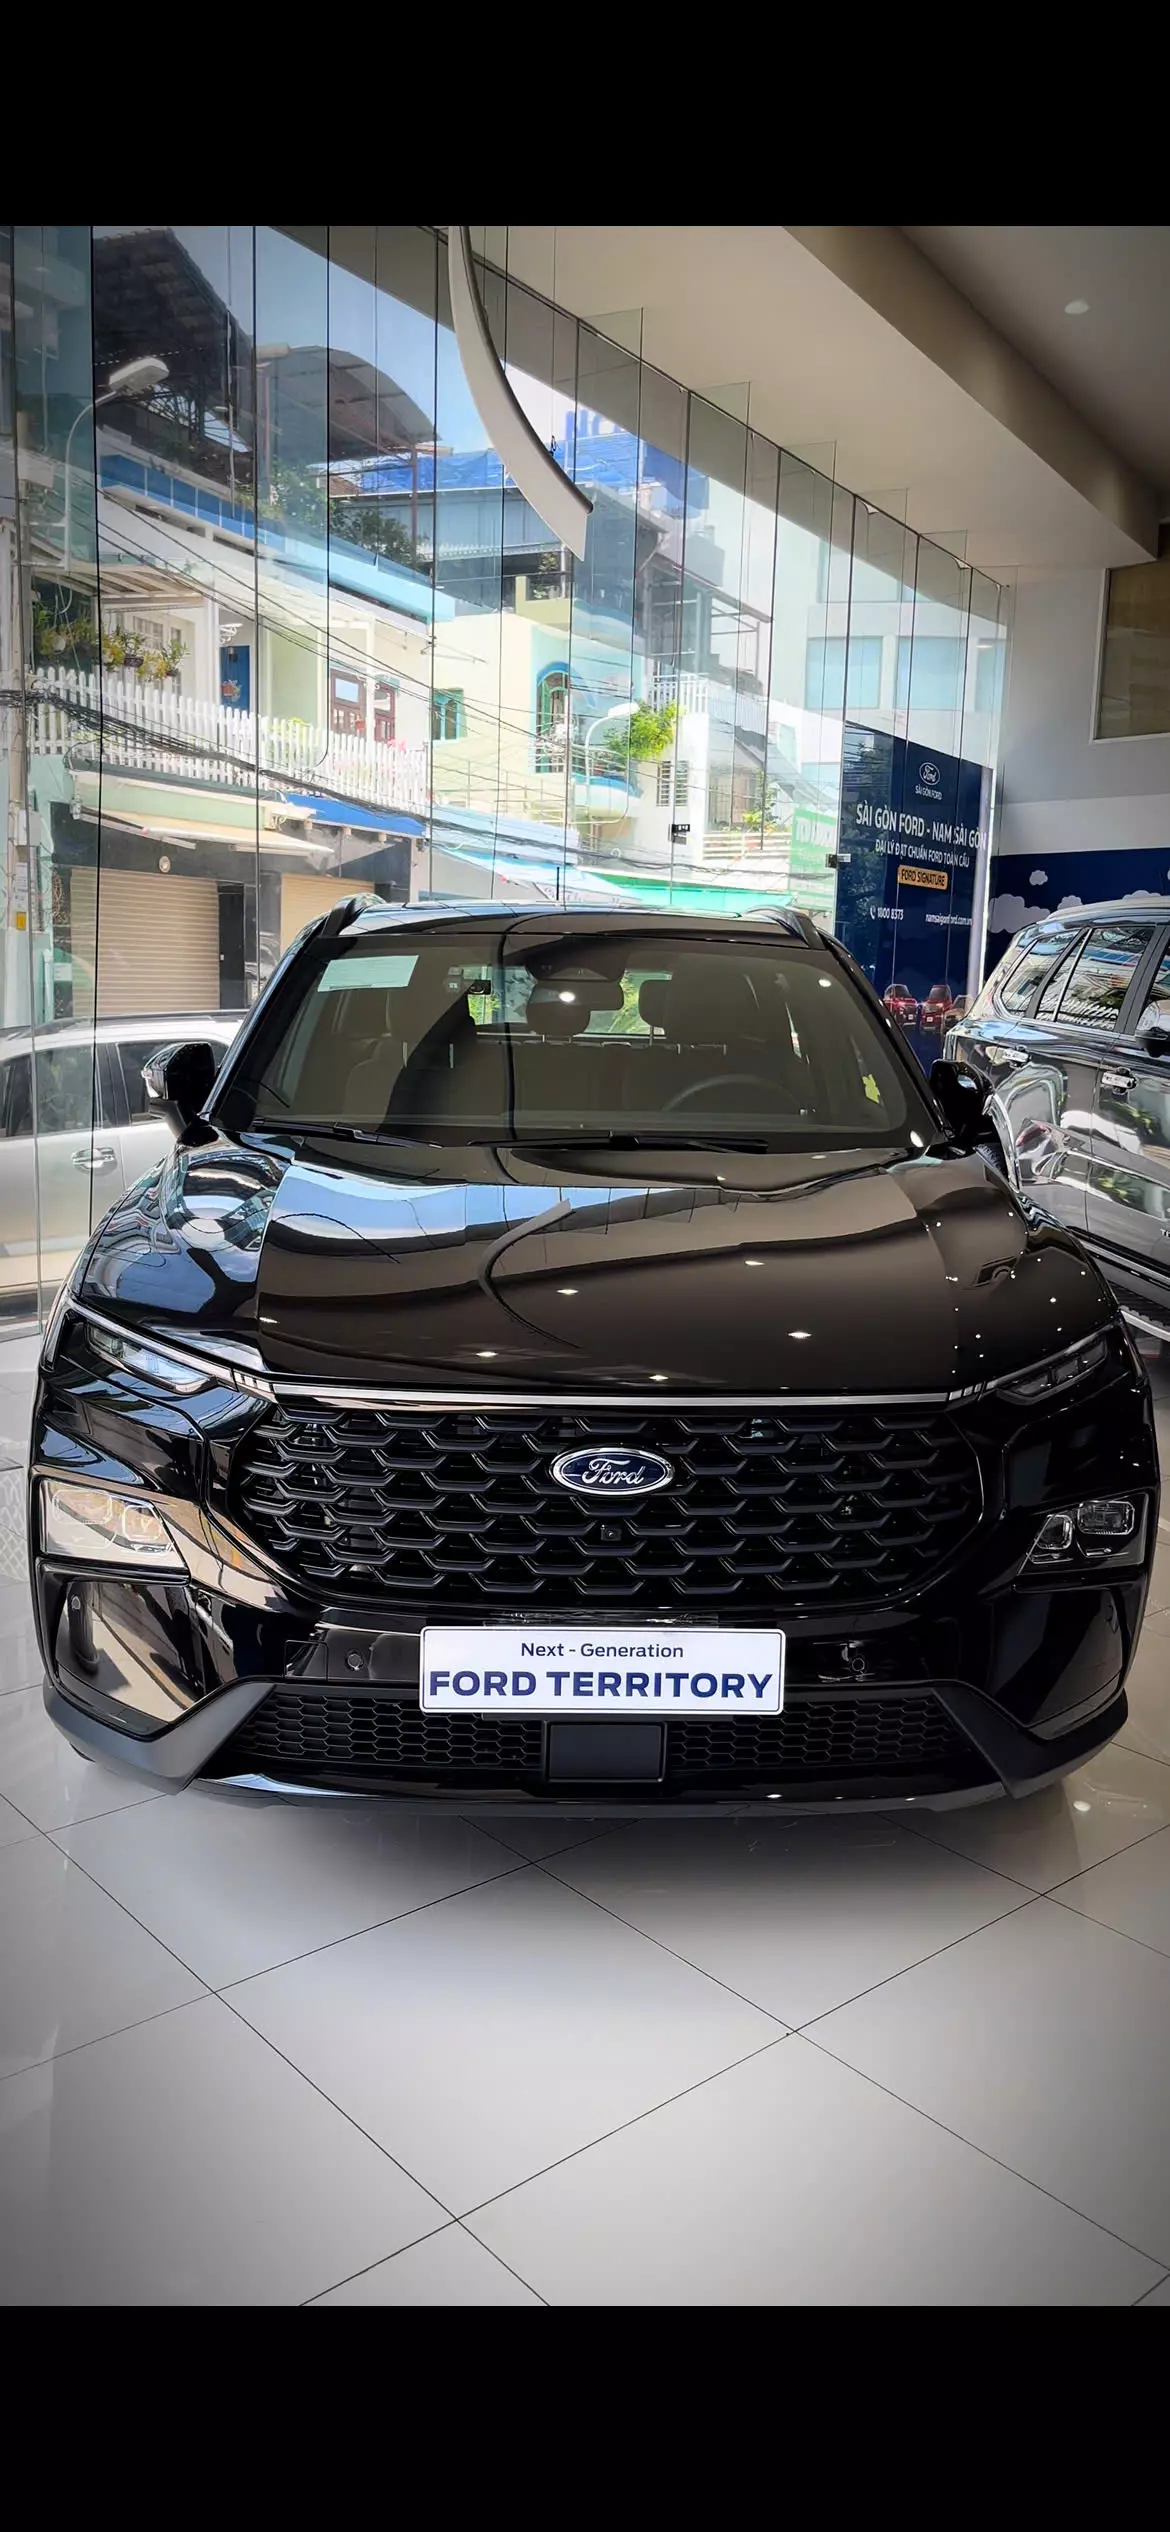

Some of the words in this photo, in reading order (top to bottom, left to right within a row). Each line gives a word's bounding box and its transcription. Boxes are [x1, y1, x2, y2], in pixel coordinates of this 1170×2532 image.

[923, 765, 937, 782] Ford
[856, 799, 873, 827] SÀI
[875, 804, 897, 832] GÒN
[899, 813, 925, 837] FORD
[932, 821, 953, 844] NAM
[953, 822, 968, 846] SÀI
[968, 826, 987, 850] GÒN
[875, 839, 887, 856] ĐẠI
[887, 840, 895, 855] LÝ
[928, 849, 943, 863] FORD
[901, 869, 916, 882] FORD
[917, 871, 945, 886] SIGNATURE
[582, 1458, 644, 1485] Ford
[521, 1642, 564, 1657] Next
[580, 1642, 684, 1658] Generation
[429, 1671, 537, 1697] FORD
[546, 1671, 773, 1699] TERRITORY
